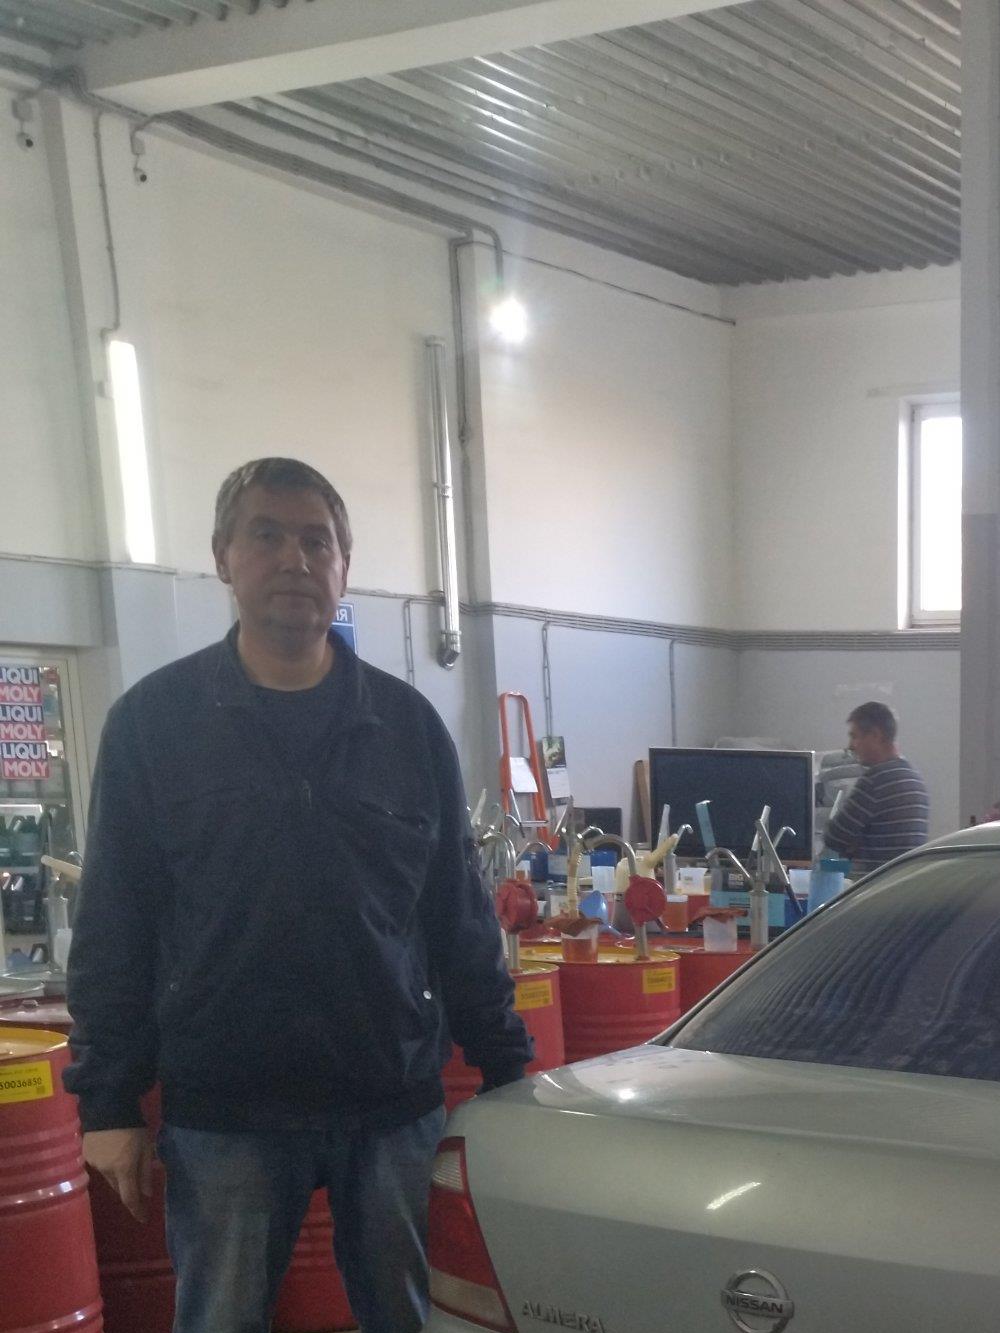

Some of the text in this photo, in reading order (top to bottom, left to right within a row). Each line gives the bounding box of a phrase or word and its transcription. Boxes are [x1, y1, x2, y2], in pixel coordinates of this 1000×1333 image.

[0, 668, 39, 685] IQUI
[0, 705, 43, 722] LIQUI
[0, 723, 44, 740] MOLY
[2, 743, 47, 760] LIQUI
[4, 761, 48, 777] MOLY
[726, 1294, 783, 1314] NISSAN
